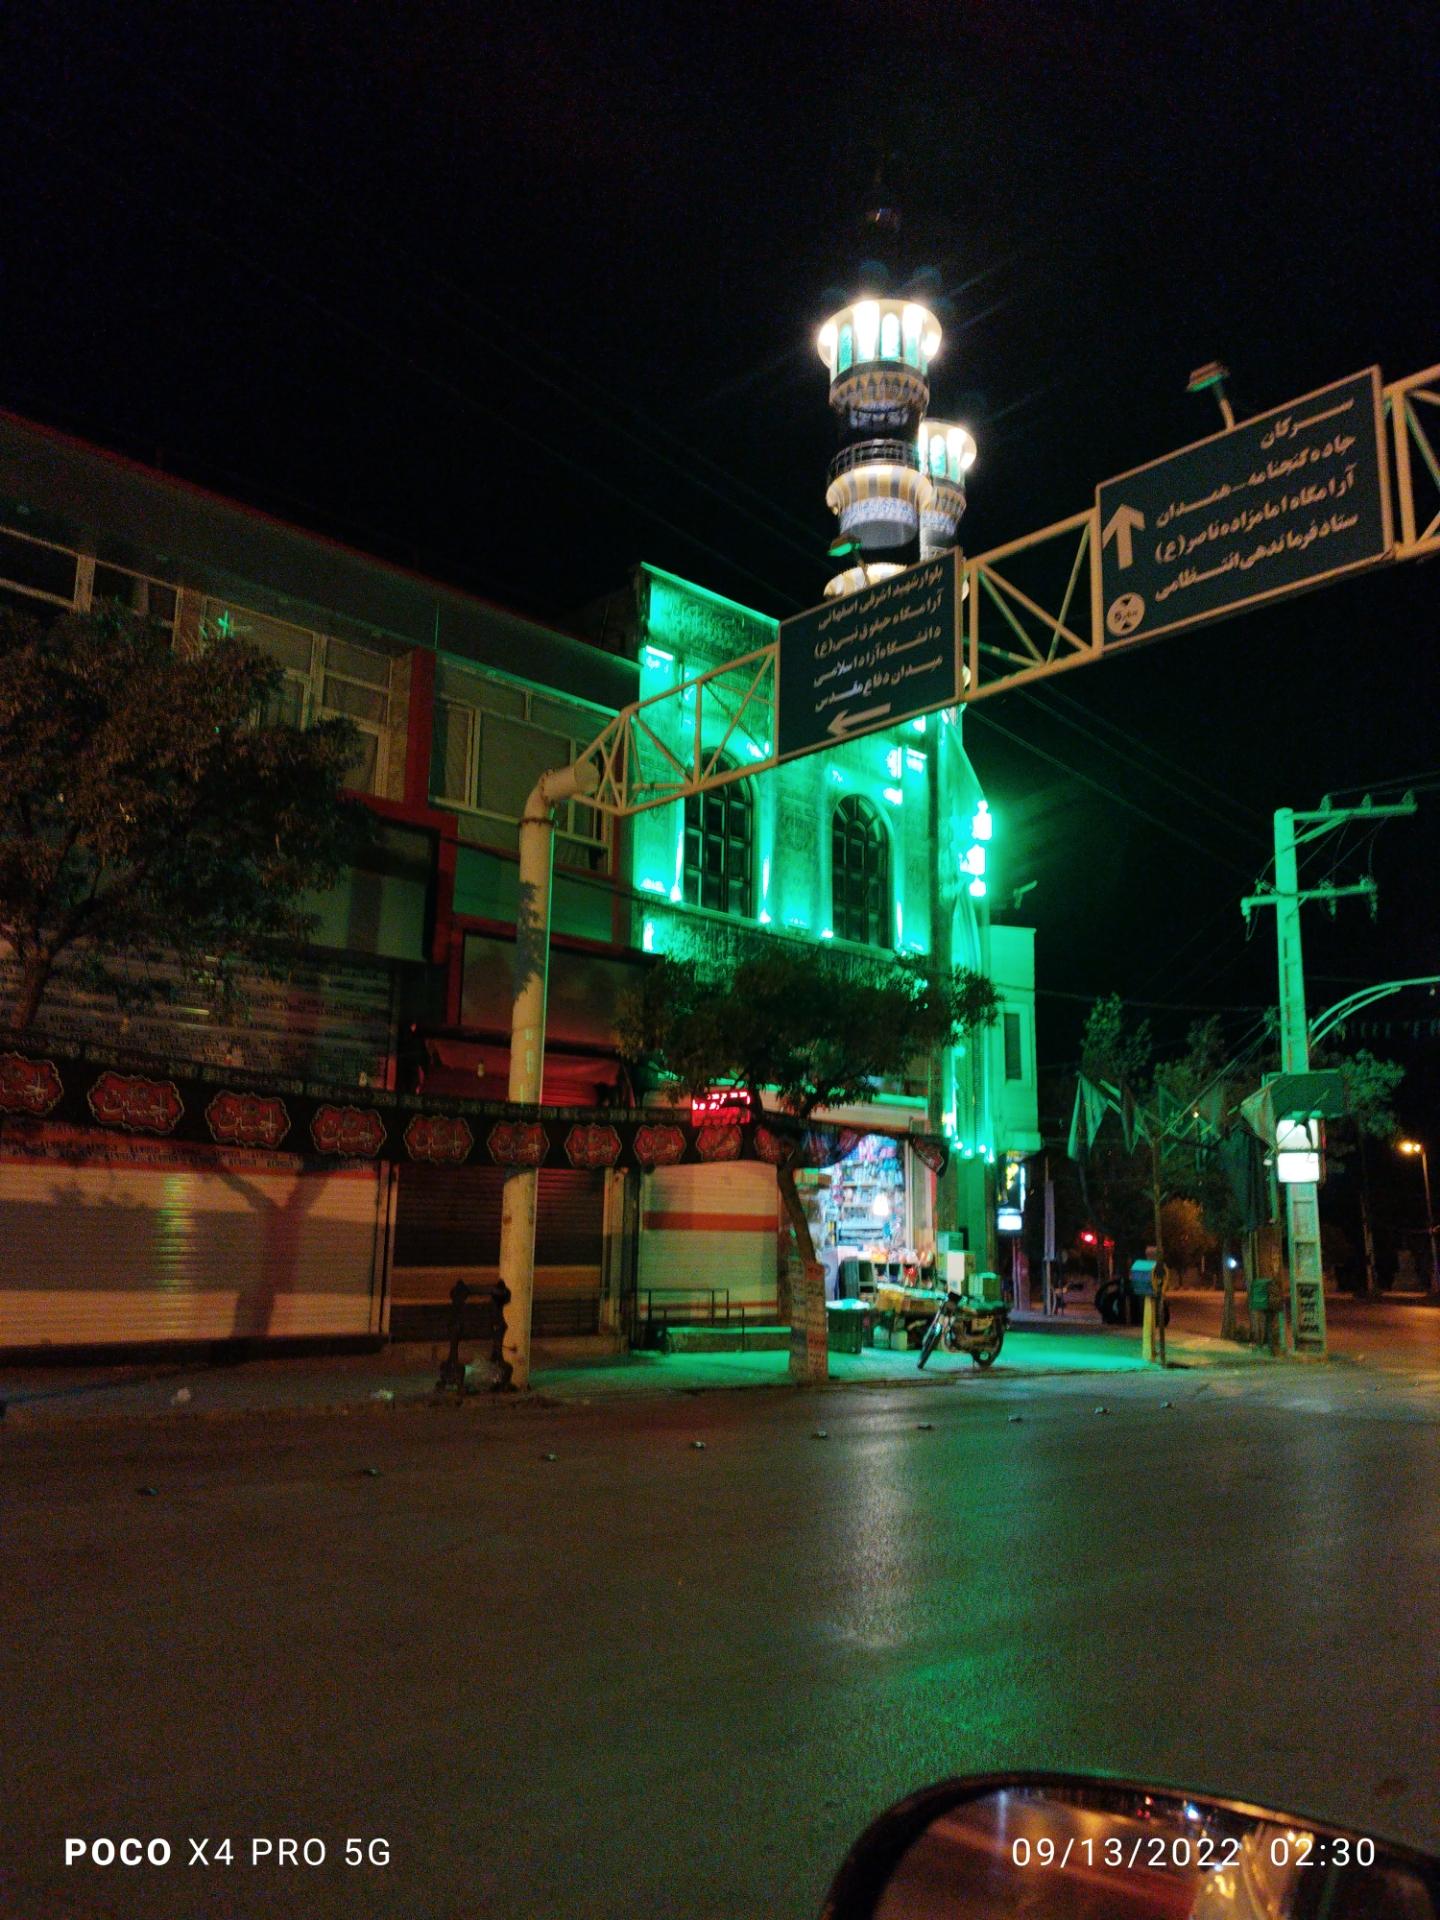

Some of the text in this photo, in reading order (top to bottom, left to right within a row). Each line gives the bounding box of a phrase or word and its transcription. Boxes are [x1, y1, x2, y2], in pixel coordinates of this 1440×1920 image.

[1310, 434, 1357, 464] جاده
[1289, 462, 1358, 510] آرامگاه
[1318, 512, 1360, 538] ستاد
[857, 642, 881, 668] آزاد
[813, 655, 858, 689] اسلامی
[814, 655, 944, 713] میدان دفاع مقدس
